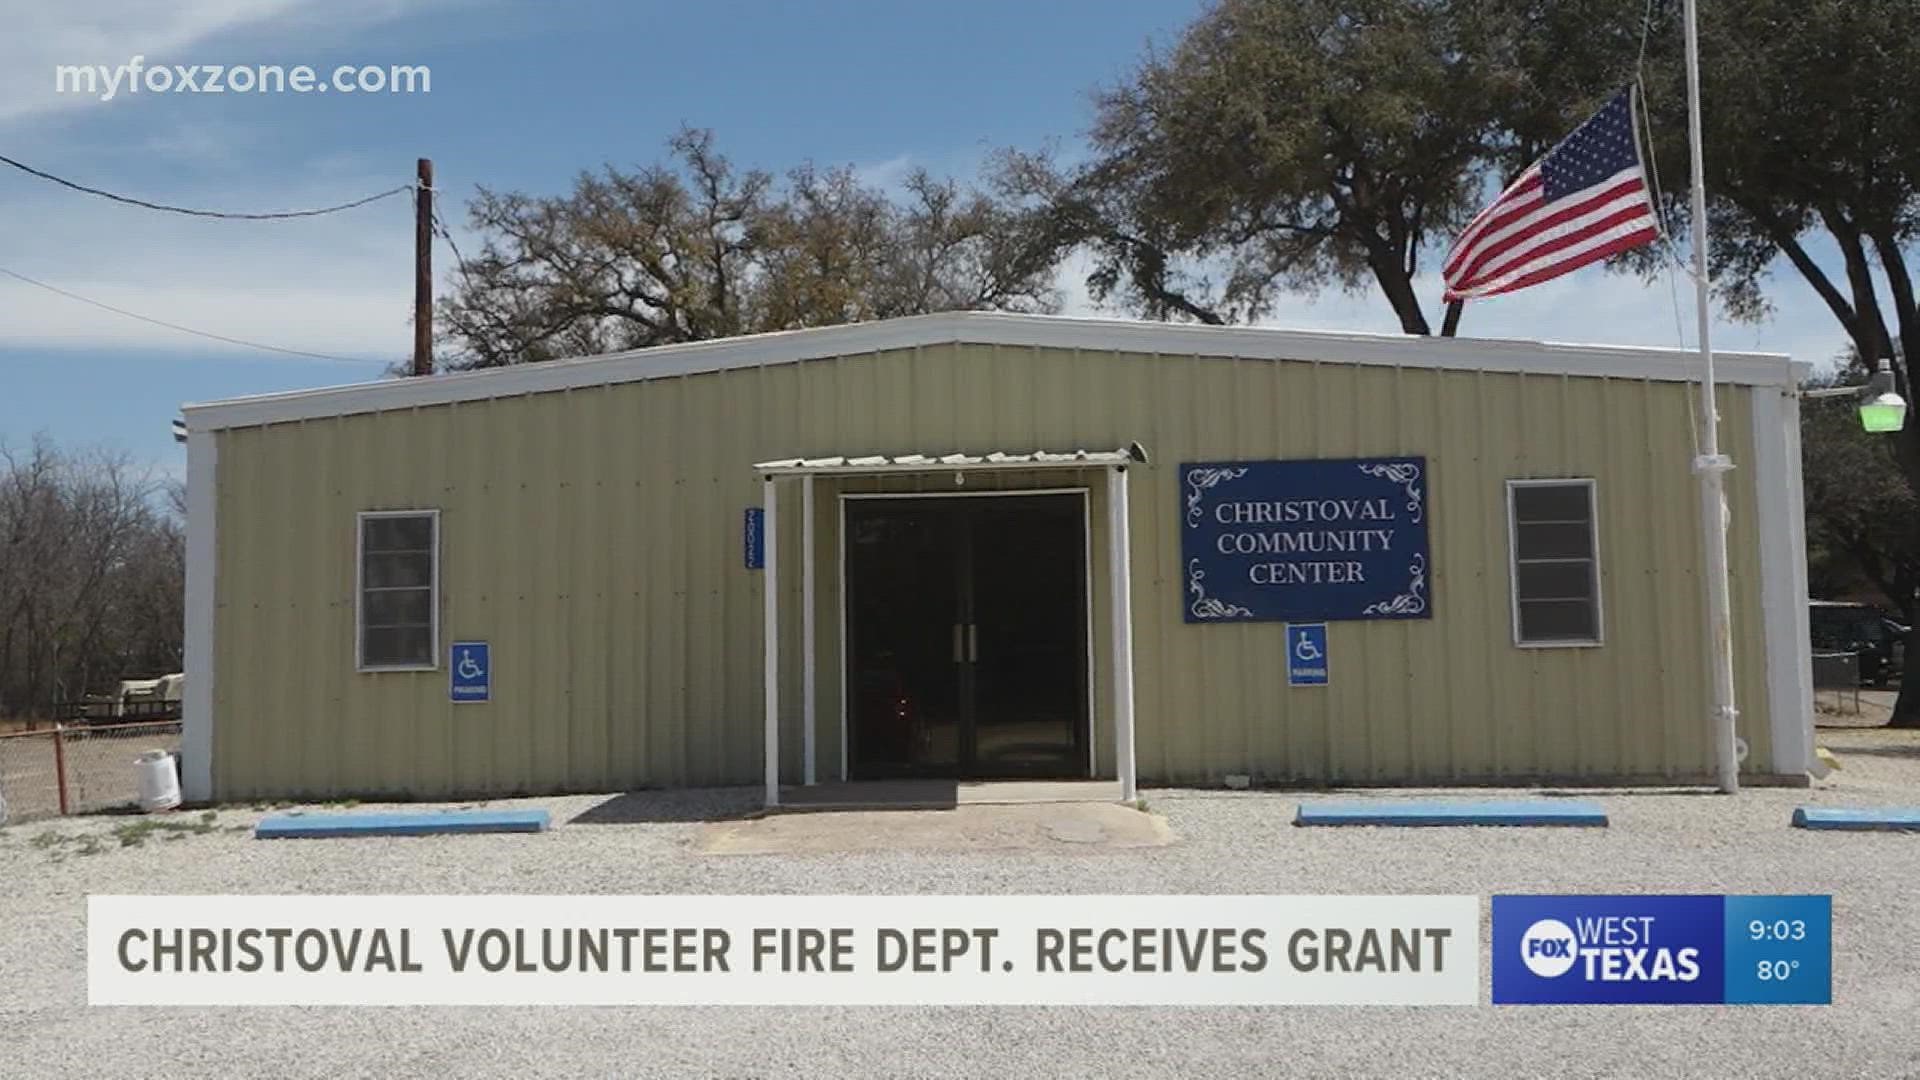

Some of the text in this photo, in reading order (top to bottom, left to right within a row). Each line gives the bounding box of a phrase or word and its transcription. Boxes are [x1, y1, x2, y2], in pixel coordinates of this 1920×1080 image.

[1215, 498, 1396, 524] CHRISTOVAL
[1217, 529, 1395, 554] COMMUNITY
[1249, 561, 1365, 584] CENTER
